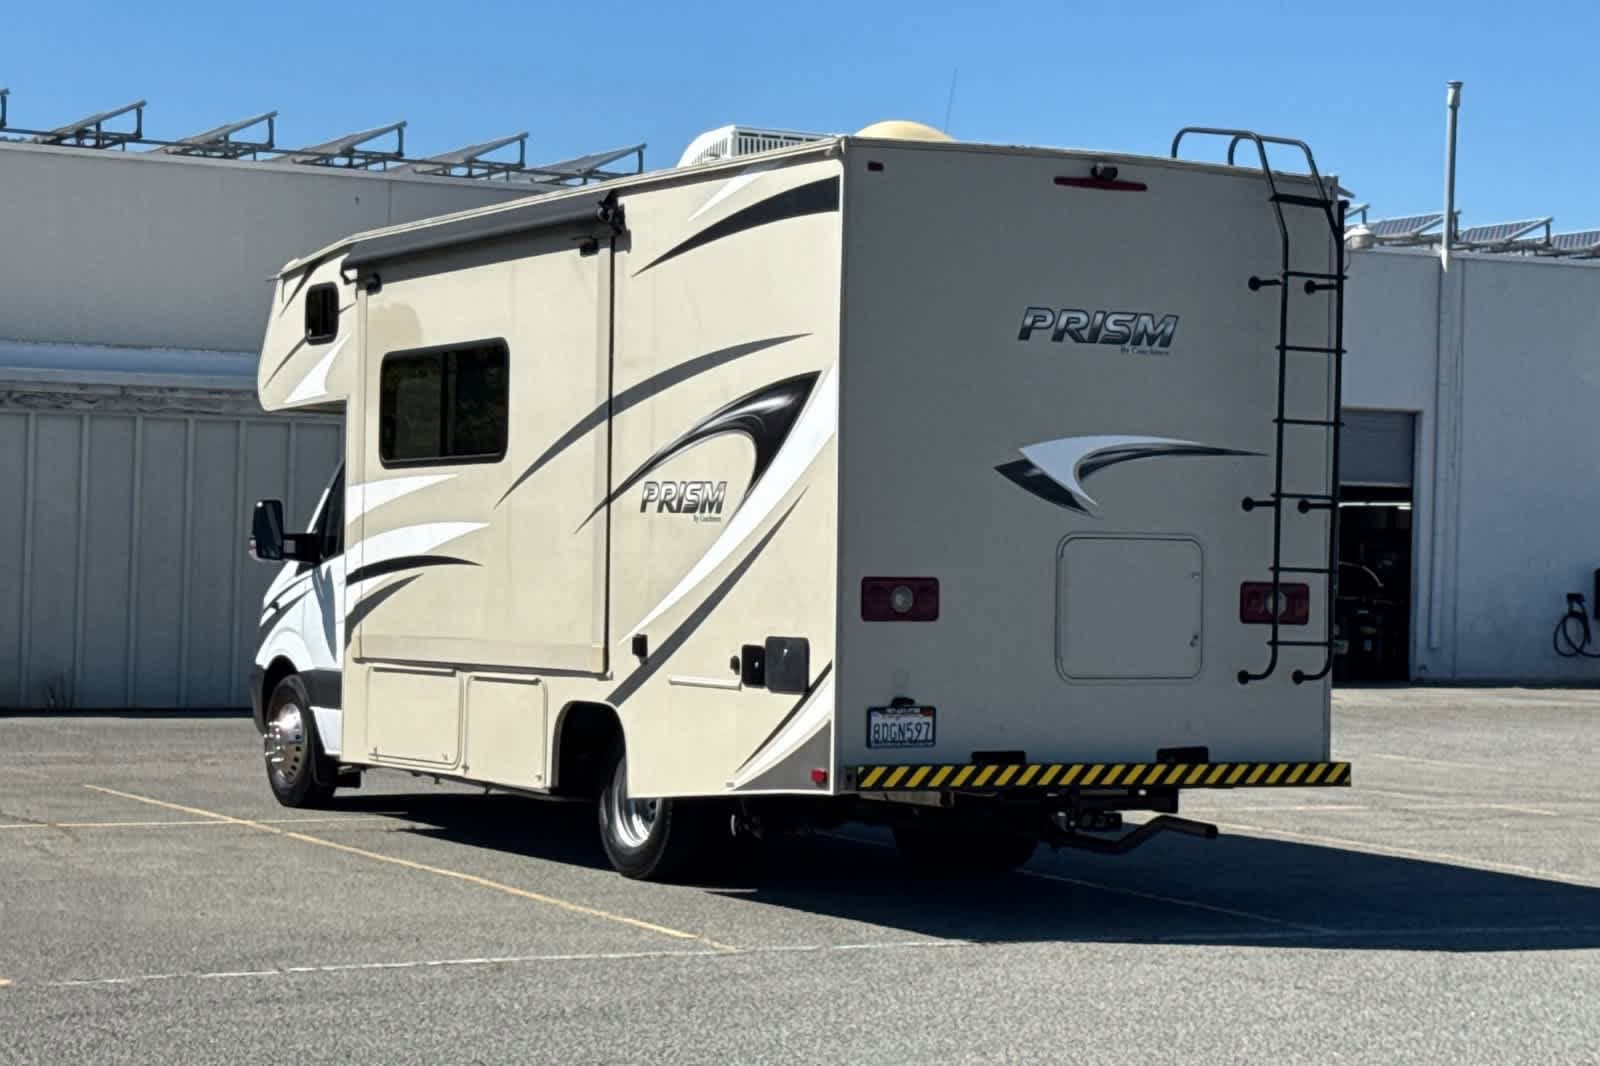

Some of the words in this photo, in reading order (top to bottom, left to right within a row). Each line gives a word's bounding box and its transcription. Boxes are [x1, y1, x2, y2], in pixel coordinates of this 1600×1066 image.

[1018, 306, 1179, 348] PRISM
[640, 481, 727, 513] PRISM
[873, 722, 931, 742] 8DGN597
